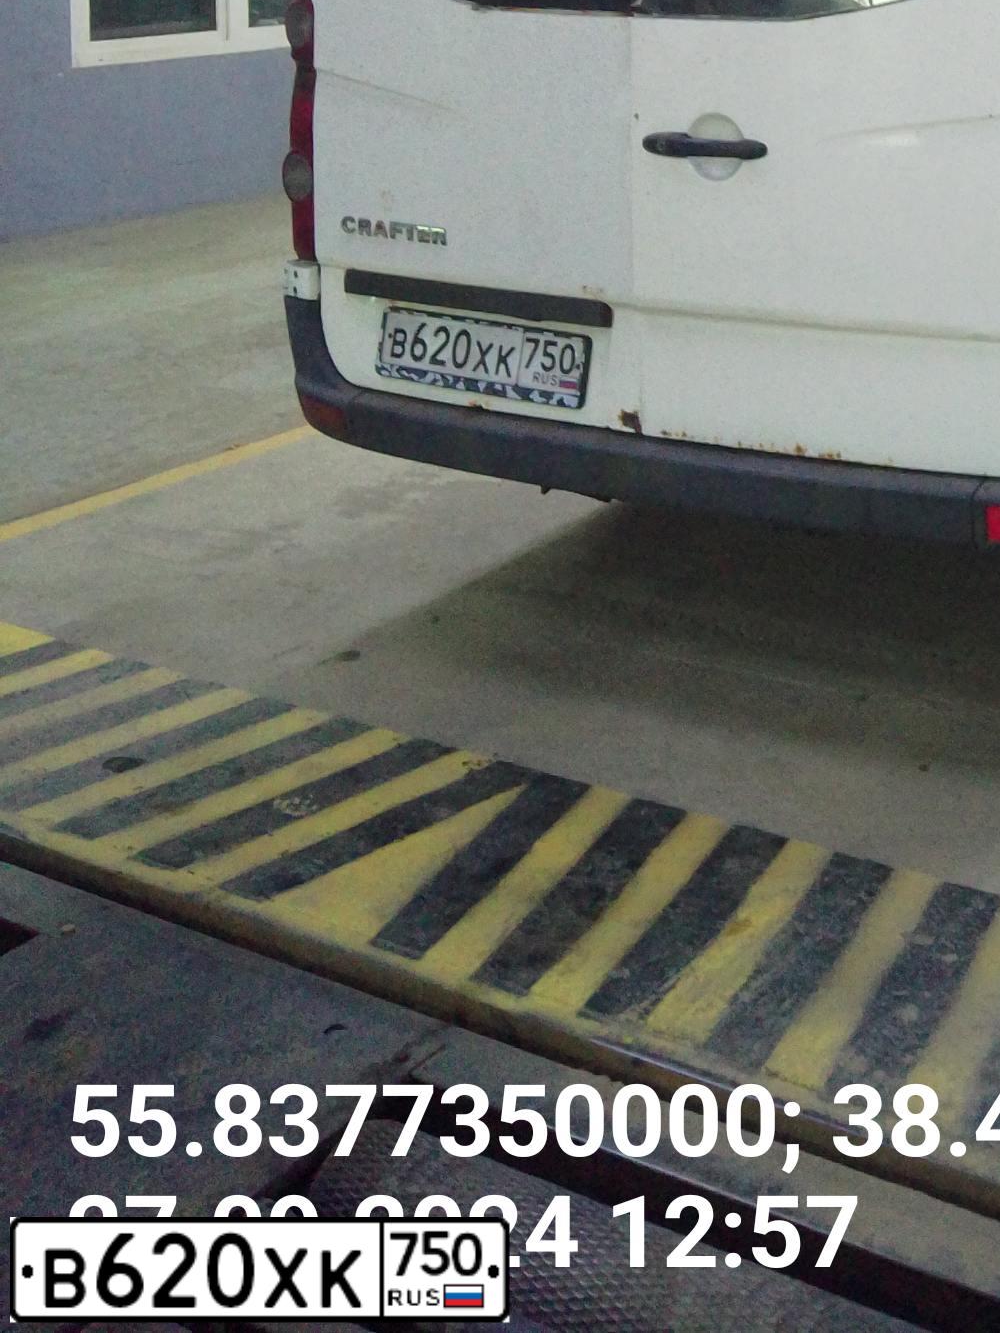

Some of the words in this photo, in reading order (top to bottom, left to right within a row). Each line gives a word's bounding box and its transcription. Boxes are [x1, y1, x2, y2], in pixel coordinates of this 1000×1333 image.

[341, 216, 447, 246] CRAFTER
[390, 322, 516, 378] В620ХК
[525, 337, 576, 375] 750
[532, 371, 559, 387] RUS
